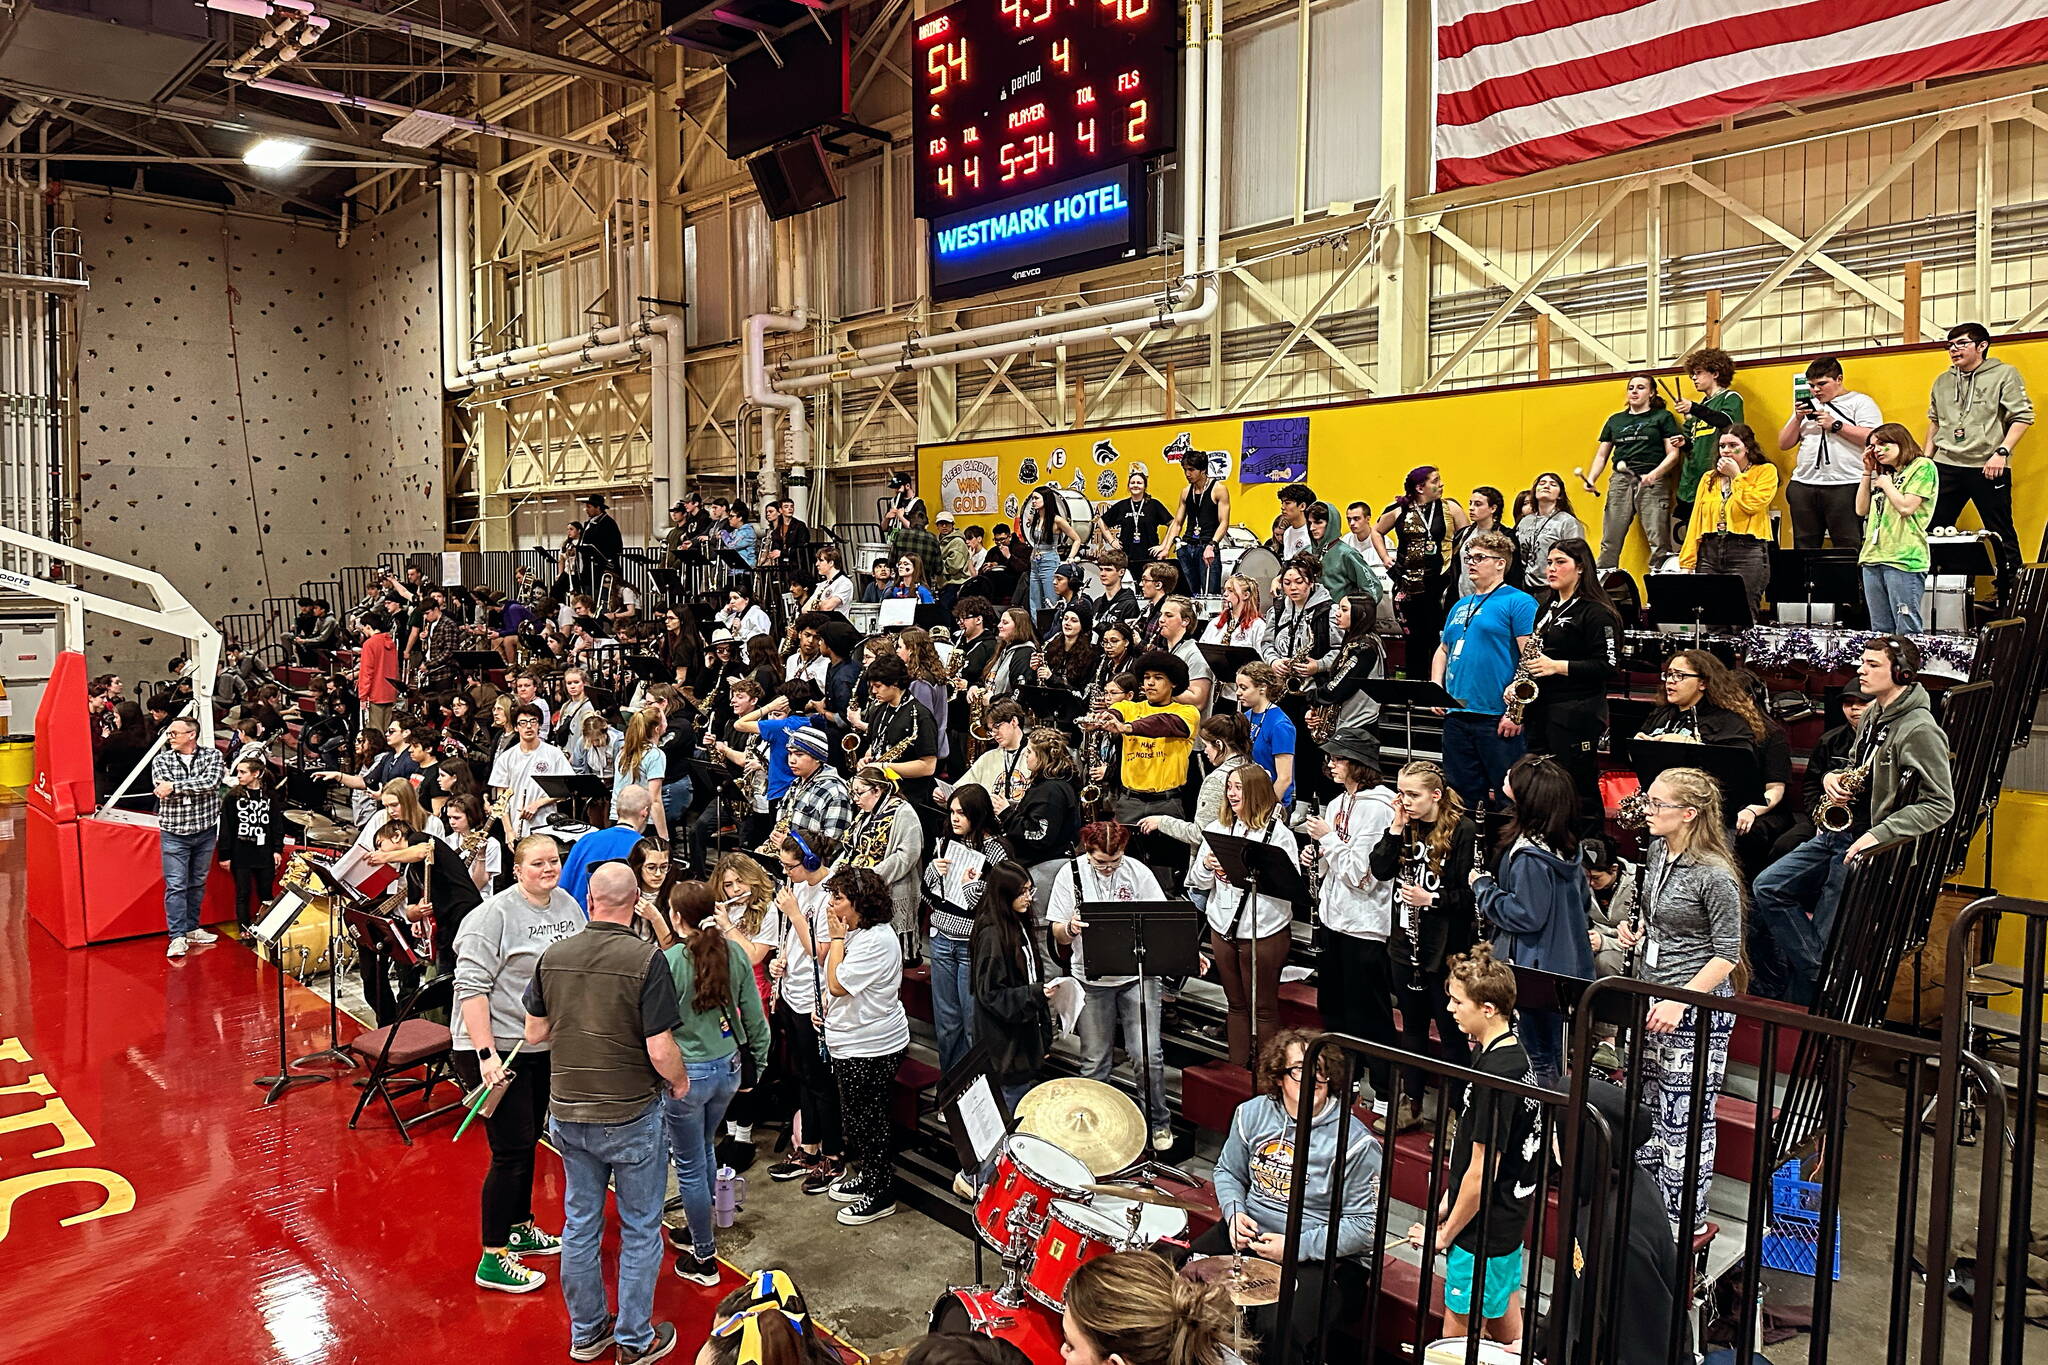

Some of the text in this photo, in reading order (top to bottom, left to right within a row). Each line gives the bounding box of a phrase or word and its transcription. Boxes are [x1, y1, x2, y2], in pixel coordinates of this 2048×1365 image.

[928, 37, 967, 95] 54
[1052, 37, 1070, 73] 4
[1011, 65, 1041, 95] period
[1118, 69, 1140, 92] FLS
[1076, 86, 1096, 106] TOL
[1008, 103, 1046, 129] PLAYER
[1128, 99, 1147, 143] 2
[930, 136, 947, 156] FLS
[962, 126, 979, 144] TOL
[1077, 117, 1095, 153] 4
[938, 164, 953, 197] 4
[964, 155, 979, 188] 4
[937, 183, 1128, 254] WESTMARK HOTEL
[1245, 418, 1309, 433] WELCOME
[1056, 452, 1063, 465] E
[941, 463, 963, 489] BLEED
[963, 459, 998, 486] CARDINAL
[956, 477, 983, 495] WIN
[953, 495, 987, 513] GOLD
[528, 920, 575, 939] PANTHERS
[1232, 1278, 1276, 1293] SABIAN
